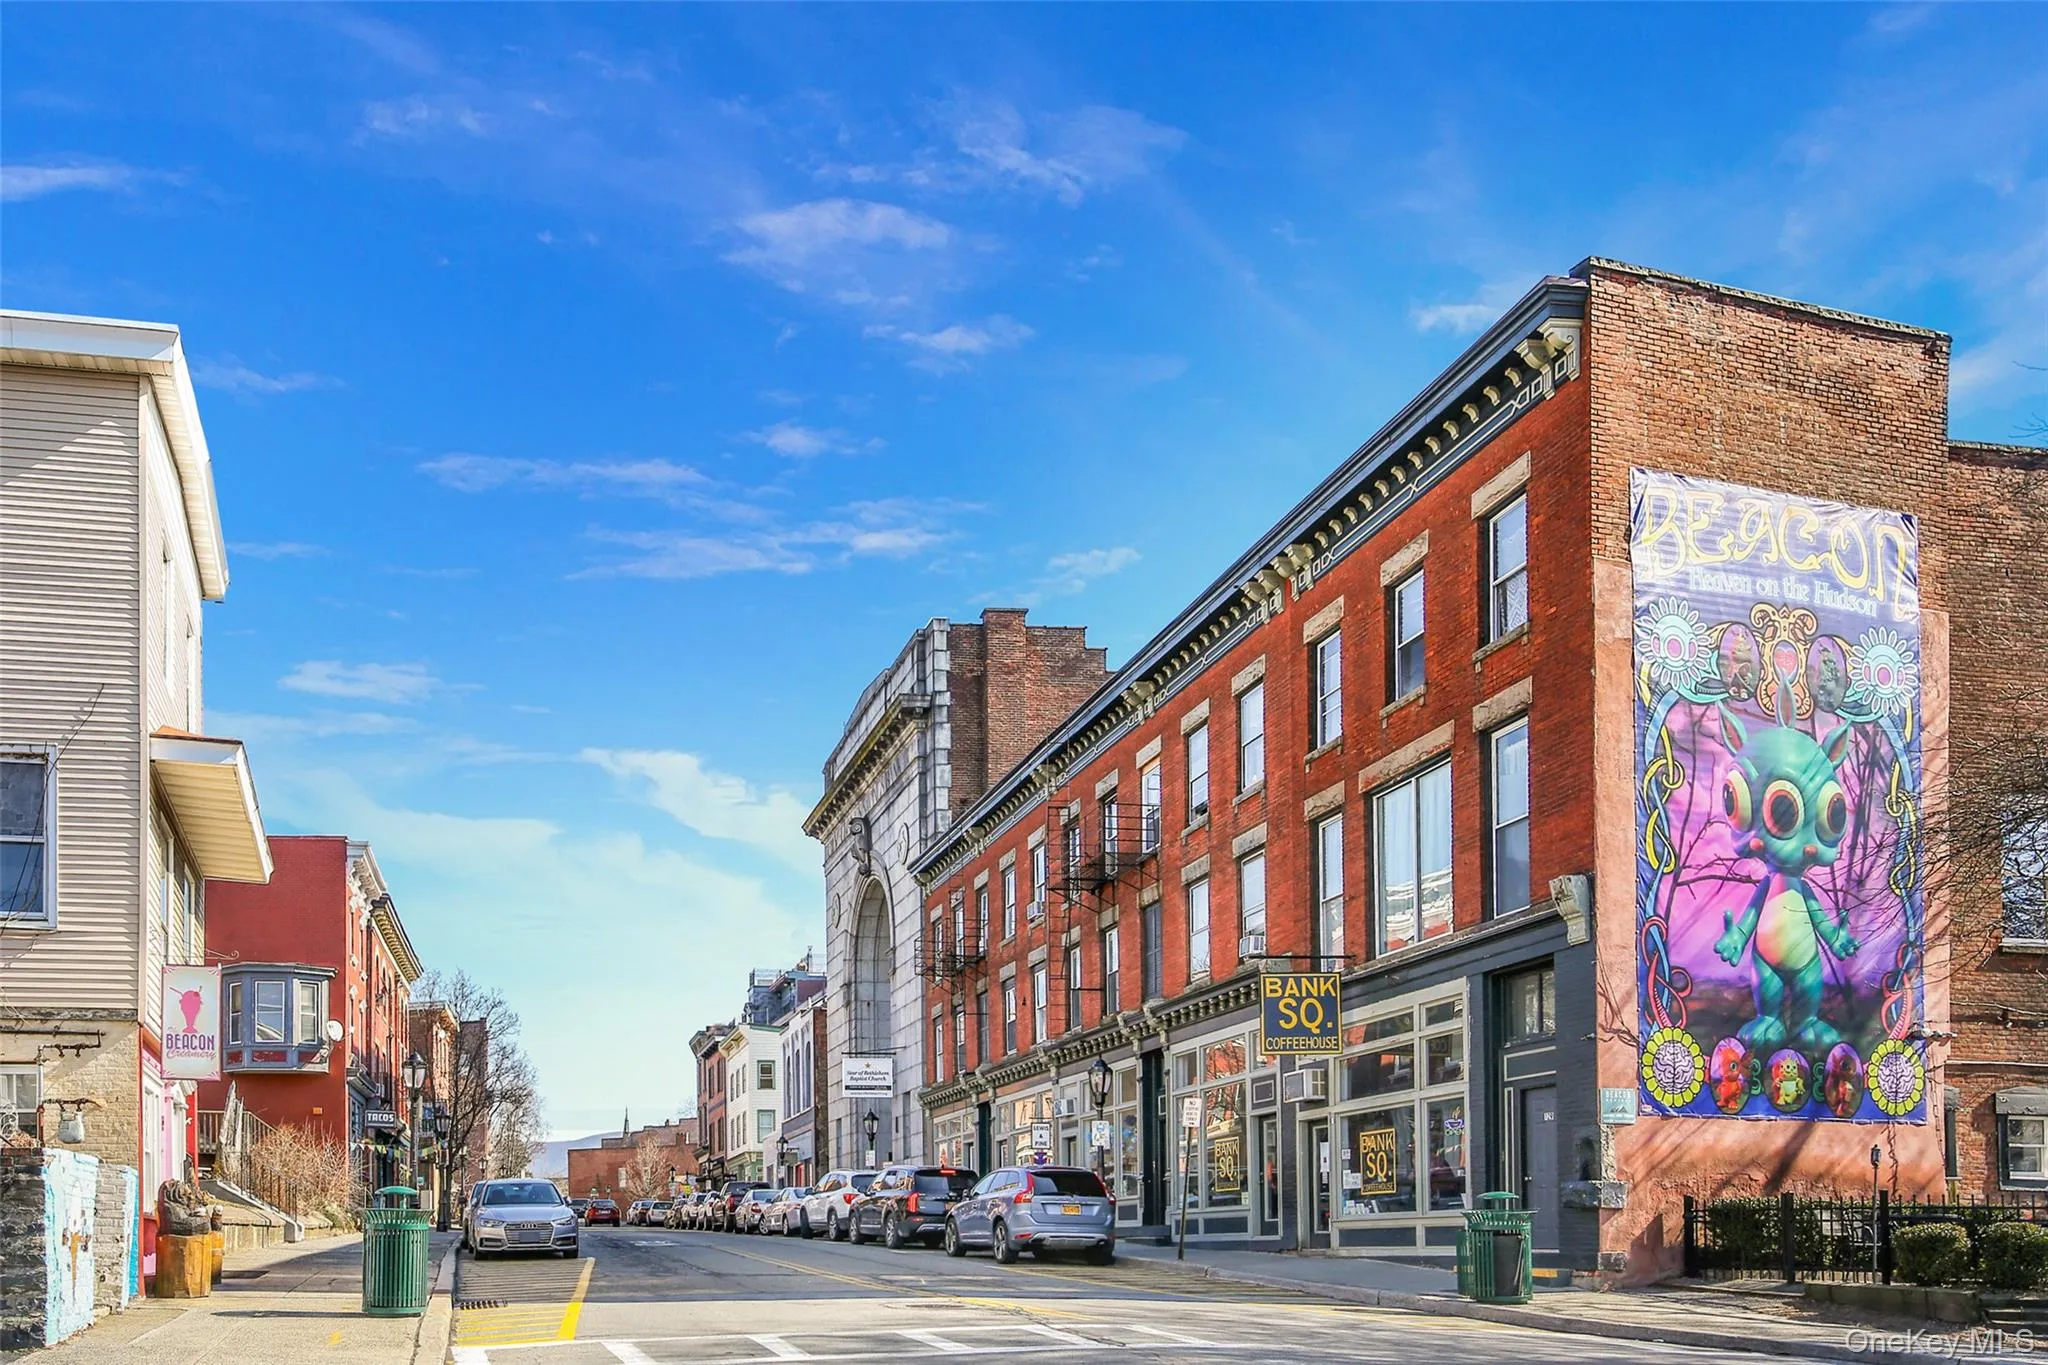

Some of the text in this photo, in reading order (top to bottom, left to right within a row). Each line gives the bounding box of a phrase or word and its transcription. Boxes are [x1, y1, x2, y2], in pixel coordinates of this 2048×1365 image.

[1687, 566, 1752, 593] Heaven
[1756, 578, 1779, 598] on
[1782, 576, 1810, 602] the
[1813, 580, 1878, 617] Hudson
[1265, 977, 1337, 997] BANK
[1278, 997, 1333, 1034] SQ.
[166, 1033, 215, 1050] BEACON
[1265, 1036, 1338, 1050] COFFEEHOUSE
[166, 1049, 217, 1060] Creamery
[367, 1113, 394, 1122] TACOS
[1445, 1129, 1465, 1137] OPEN
[1216, 1140, 1239, 1157] BANK
[1361, 1133, 1394, 1153] BANK
[1219, 1155, 1237, 1181] SQ.
[1366, 1151, 1392, 1182] SQ.
